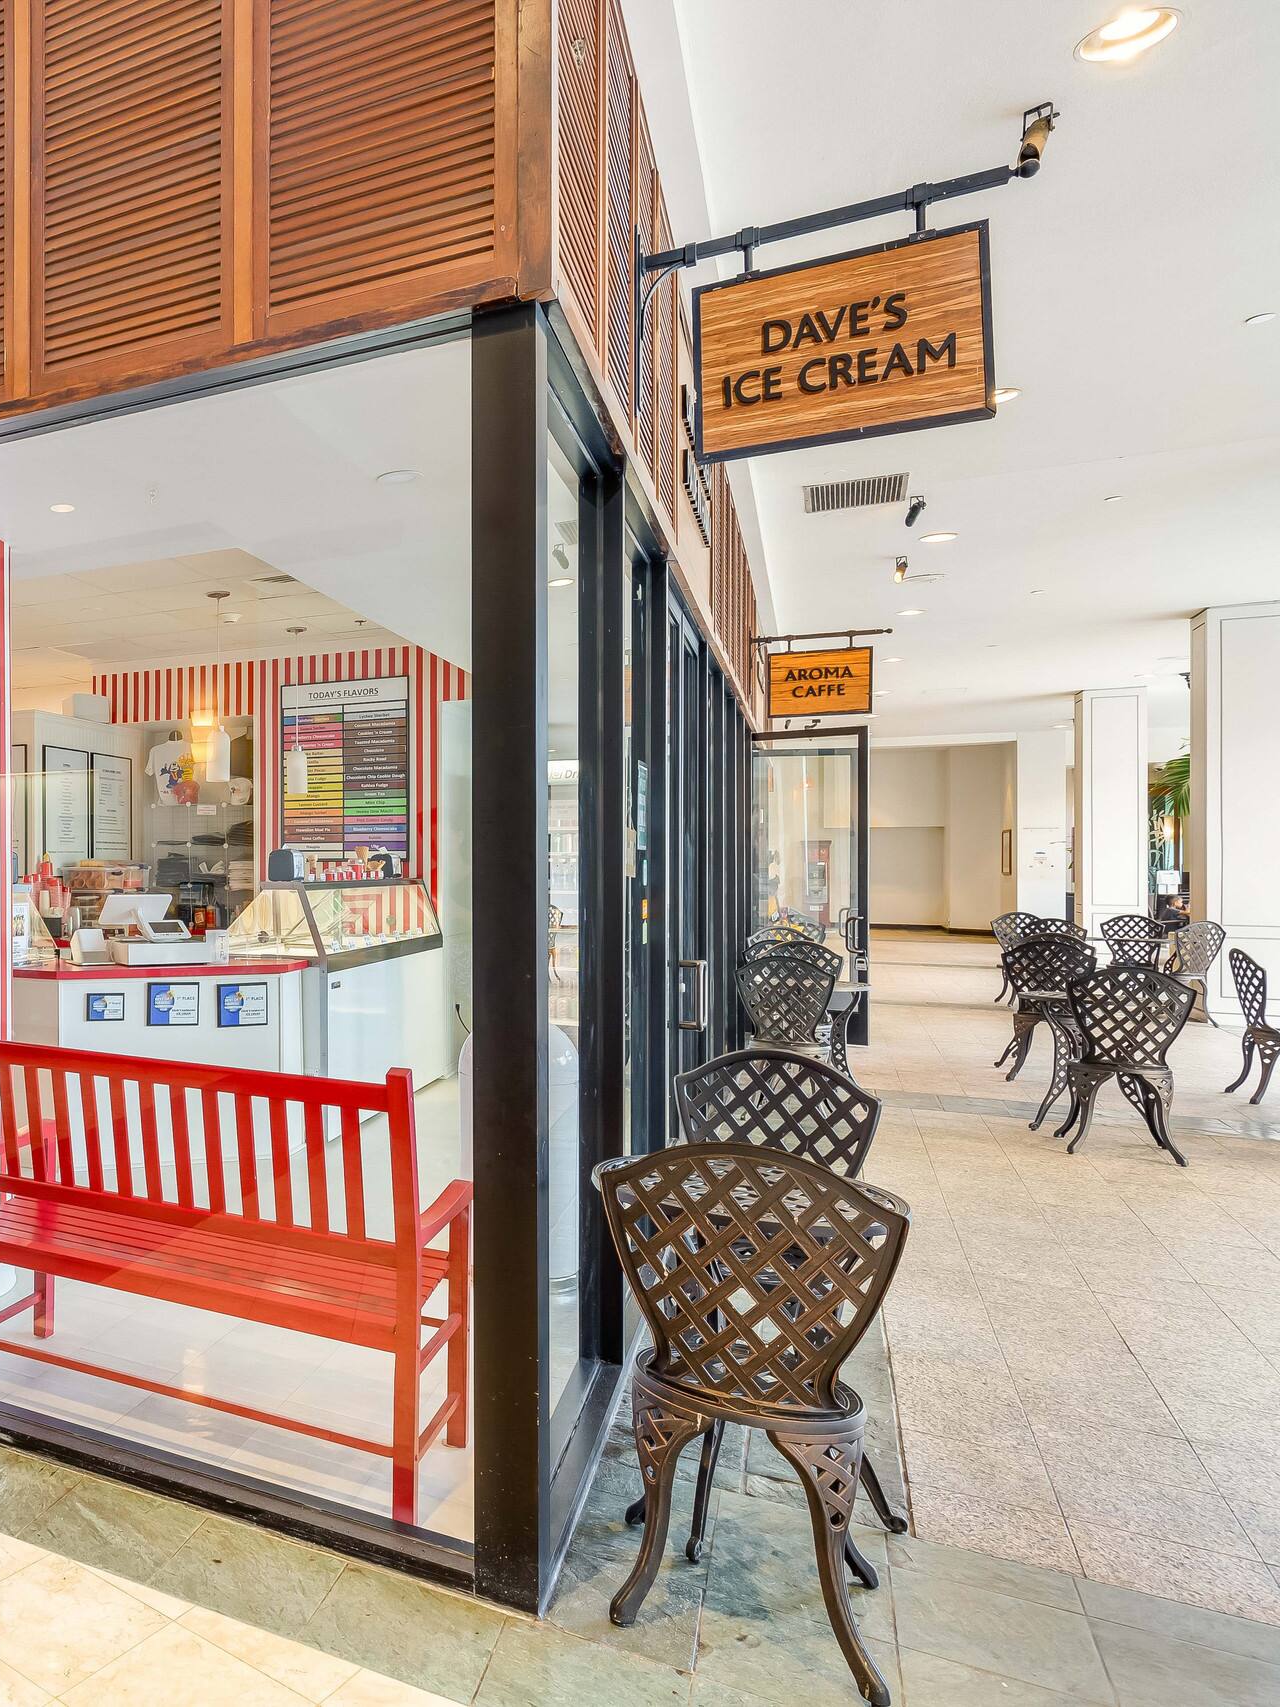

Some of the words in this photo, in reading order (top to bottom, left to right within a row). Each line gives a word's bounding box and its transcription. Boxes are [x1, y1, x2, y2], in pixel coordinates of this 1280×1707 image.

[761, 293, 908, 353] DAVE'S
[722, 366, 782, 408] ICE
[796, 333, 956, 394] CREAM
[784, 666, 853, 682] AROMA
[308, 690, 342, 700] TODAY'S
[344, 688, 378, 697] FLAVORS
[792, 684, 845, 698] CAFFE
